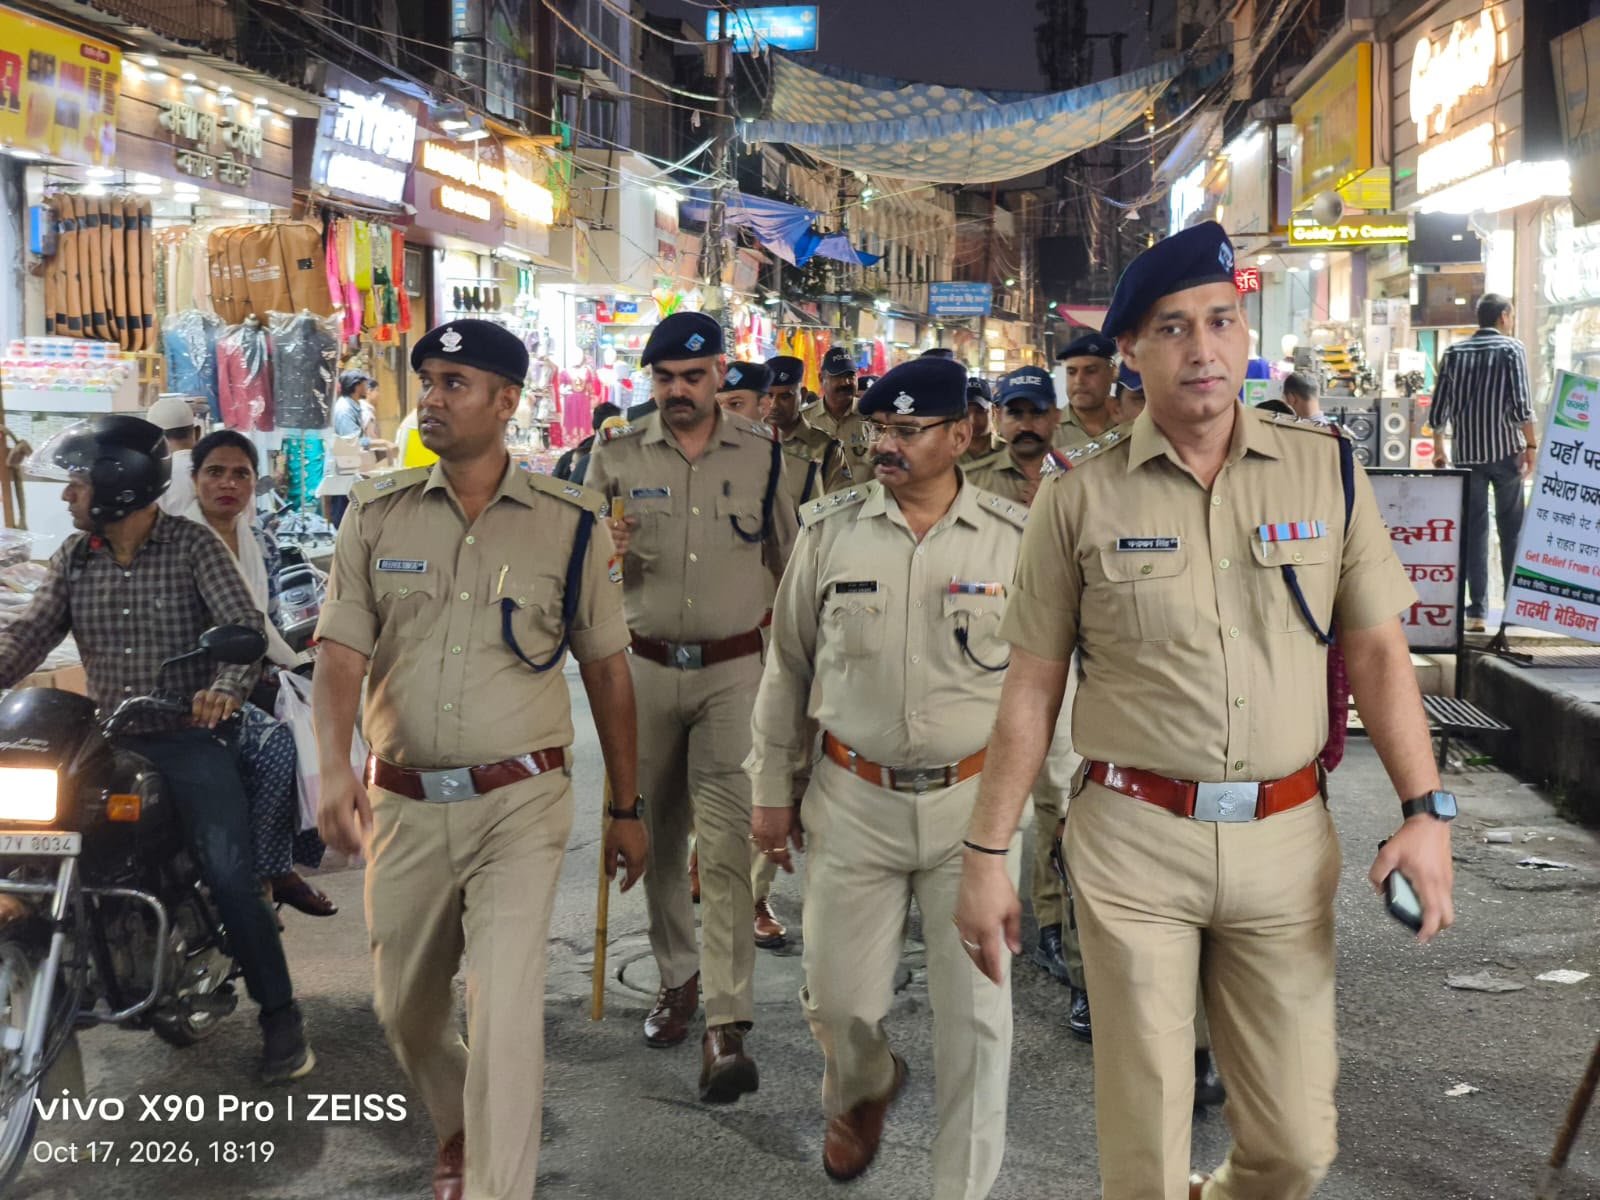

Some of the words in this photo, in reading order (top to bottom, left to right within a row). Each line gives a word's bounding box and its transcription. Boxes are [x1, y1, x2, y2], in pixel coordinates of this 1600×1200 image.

[1009, 375, 1042, 386] POLICE
[1541, 470, 1580, 501] स्पेशल
[1388, 518, 1456, 545] क्ष्मी
[1556, 537, 1576, 552] राहत
[1525, 549, 1540, 562] Get
[1542, 553, 1566, 568] Relief
[1568, 560, 1590, 574] From
[1554, 602, 1599, 631] मेडिकल
